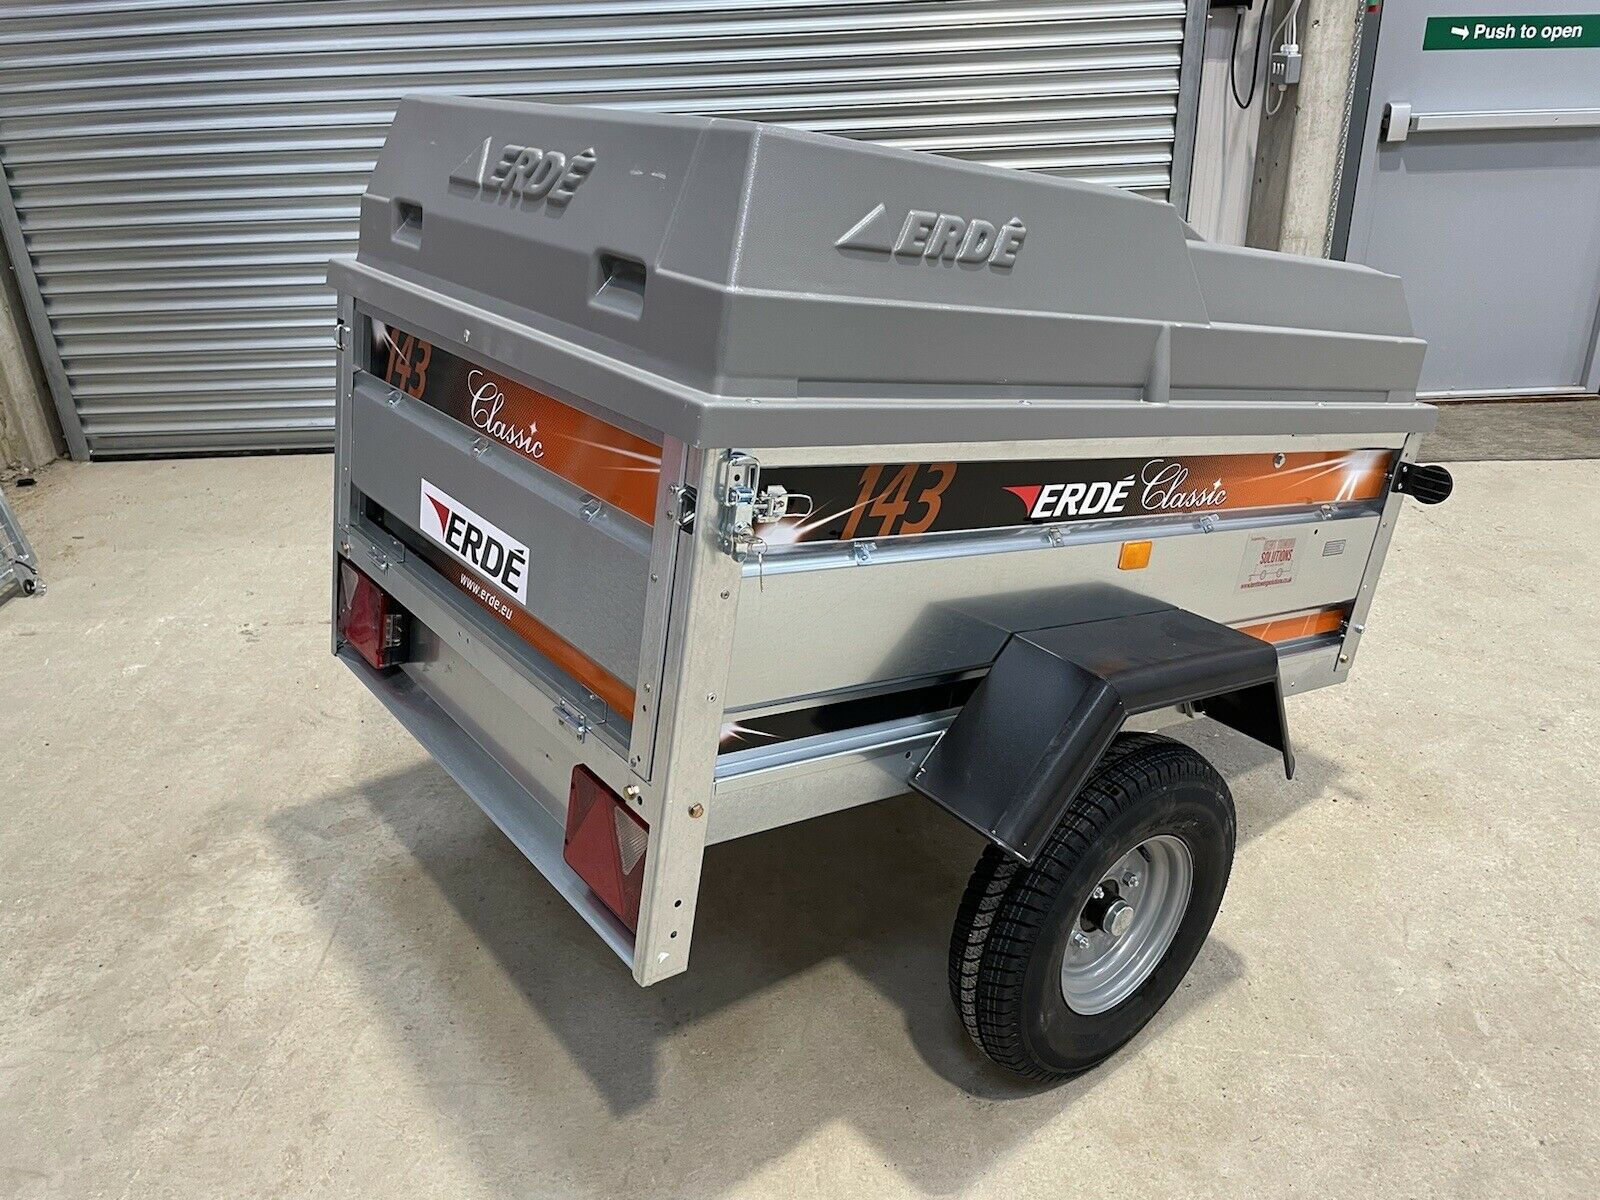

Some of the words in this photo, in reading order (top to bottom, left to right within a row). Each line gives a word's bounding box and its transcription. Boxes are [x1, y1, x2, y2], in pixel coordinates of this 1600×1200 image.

[1473, 23, 1516, 40] Push
[1520, 24, 1537, 39] to
[1541, 25, 1583, 42] open
[481, 143, 598, 208] ERDÉ
[894, 208, 1027, 269] ERDÉ
[385, 324, 433, 400] 143
[467, 369, 544, 459] Classic
[840, 462, 958, 540] 143
[1030, 474, 1136, 519] ERDÉ
[1141, 458, 1227, 511] Classic
[445, 511, 526, 594] ERDÉ
[1259, 549, 1294, 565] SOLUTIONS
[460, 573, 513, 620] www.erde.eu
